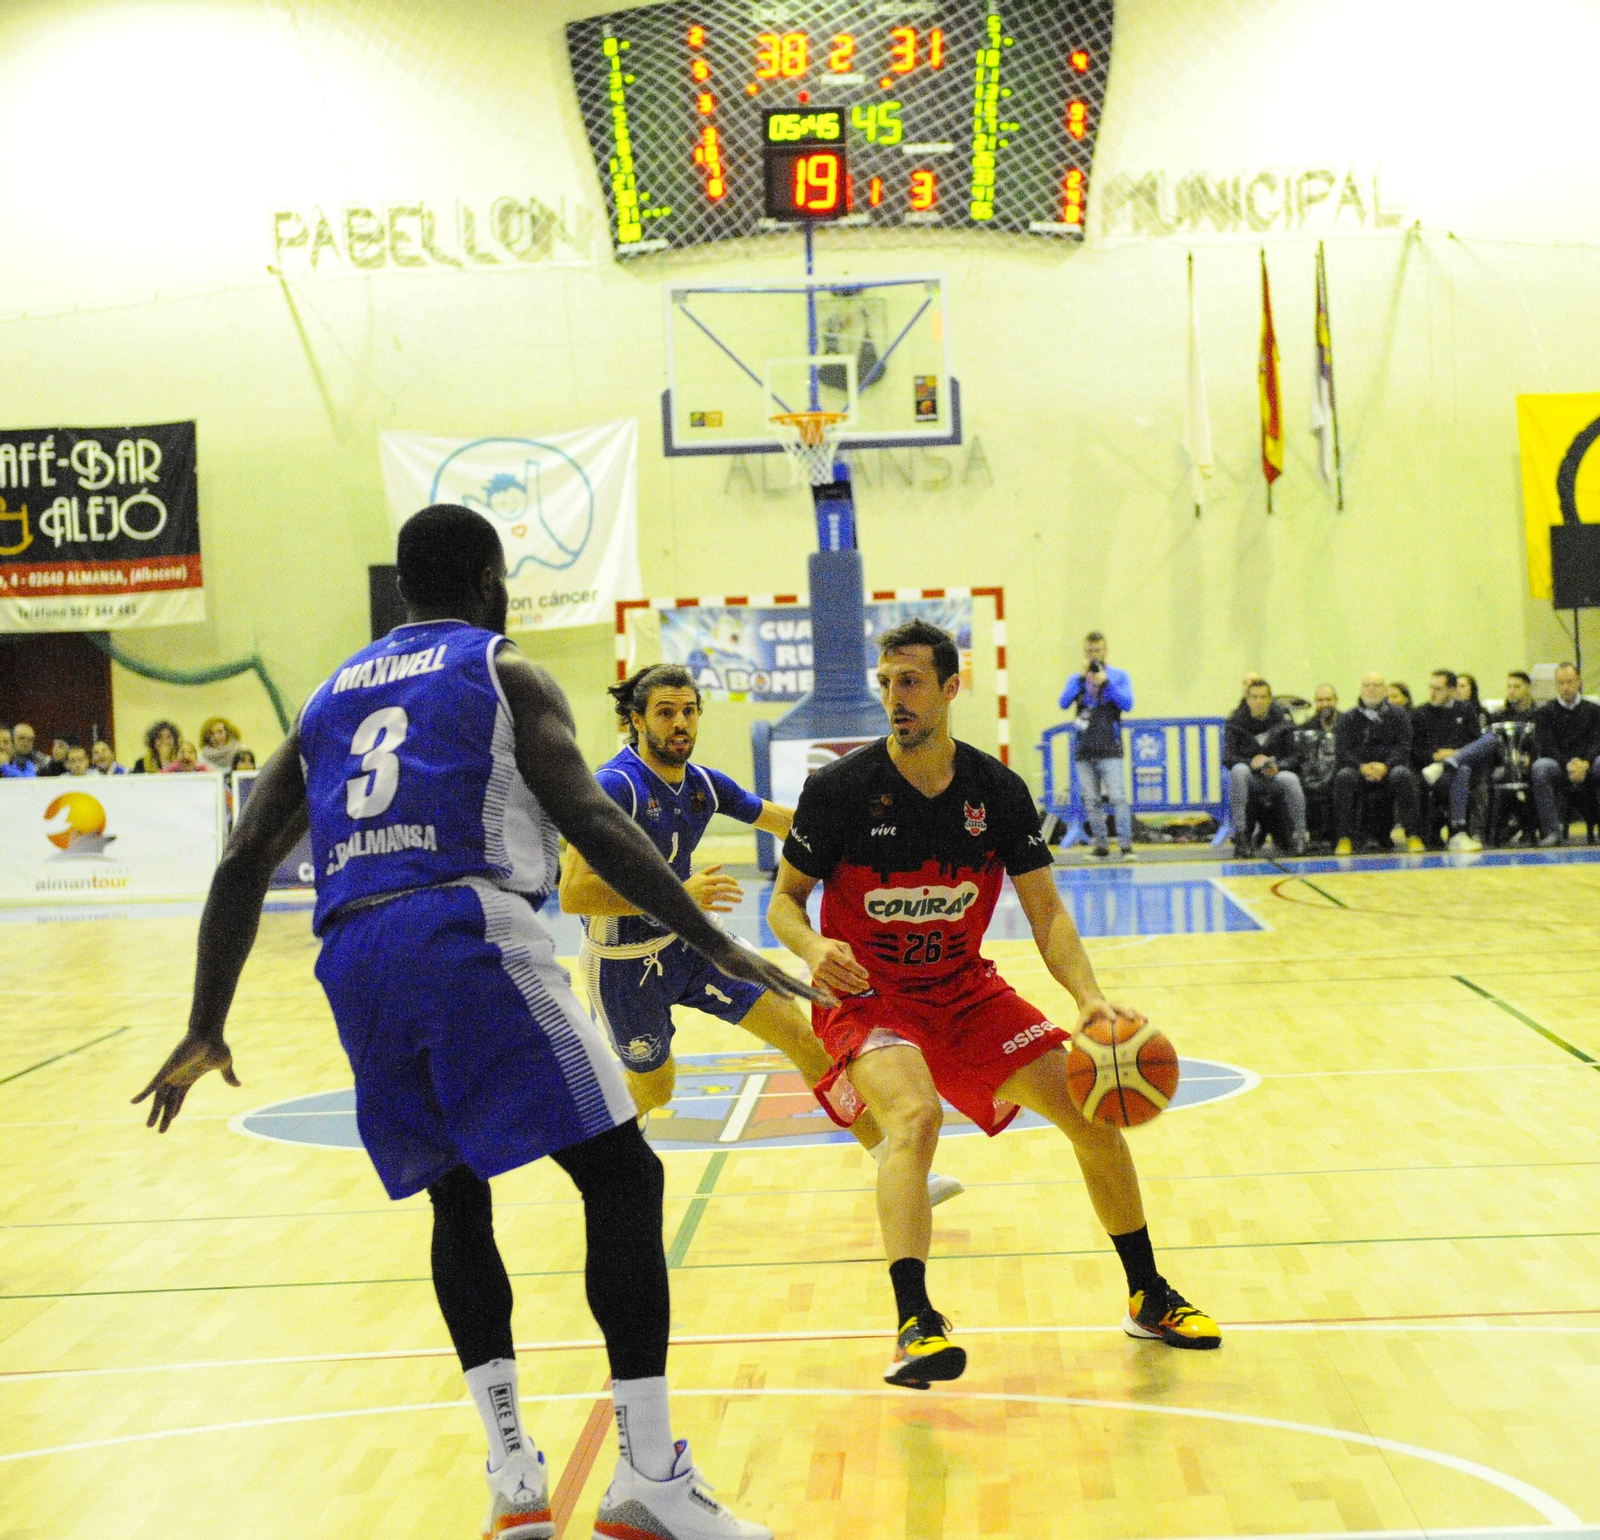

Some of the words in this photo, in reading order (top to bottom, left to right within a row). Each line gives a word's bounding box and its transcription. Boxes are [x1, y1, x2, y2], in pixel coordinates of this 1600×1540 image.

[689, 27, 703, 46] 2
[755, 32, 808, 78] 38
[830, 35, 855, 73] 2
[891, 28, 943, 73] 31
[693, 60, 708, 80] 5
[1071, 51, 1087, 71] 4
[698, 94, 713, 113] 3
[769, 113, 839, 141] 05:45
[851, 101, 902, 145] 45
[795, 154, 837, 210] 19
[870, 177, 881, 208] 1
[910, 170, 938, 212] 3
[1100, 161, 1403, 236] MUNICIPAL
[0, 433, 163, 491] AFÉ-BAR
[722, 434, 993, 500] ALANSA
[38, 486, 168, 548] ALEJÓ
[66, 568, 128, 587] ALMANSA,
[509, 597, 532, 611] on
[537, 588, 599, 609] cáncer
[332, 644, 448, 695] MAXWELL
[345, 705, 409, 820] 3
[902, 930, 943, 966] 26
[493, 1387, 513, 1420] NIKE
[501, 1426, 521, 1454] AIR
